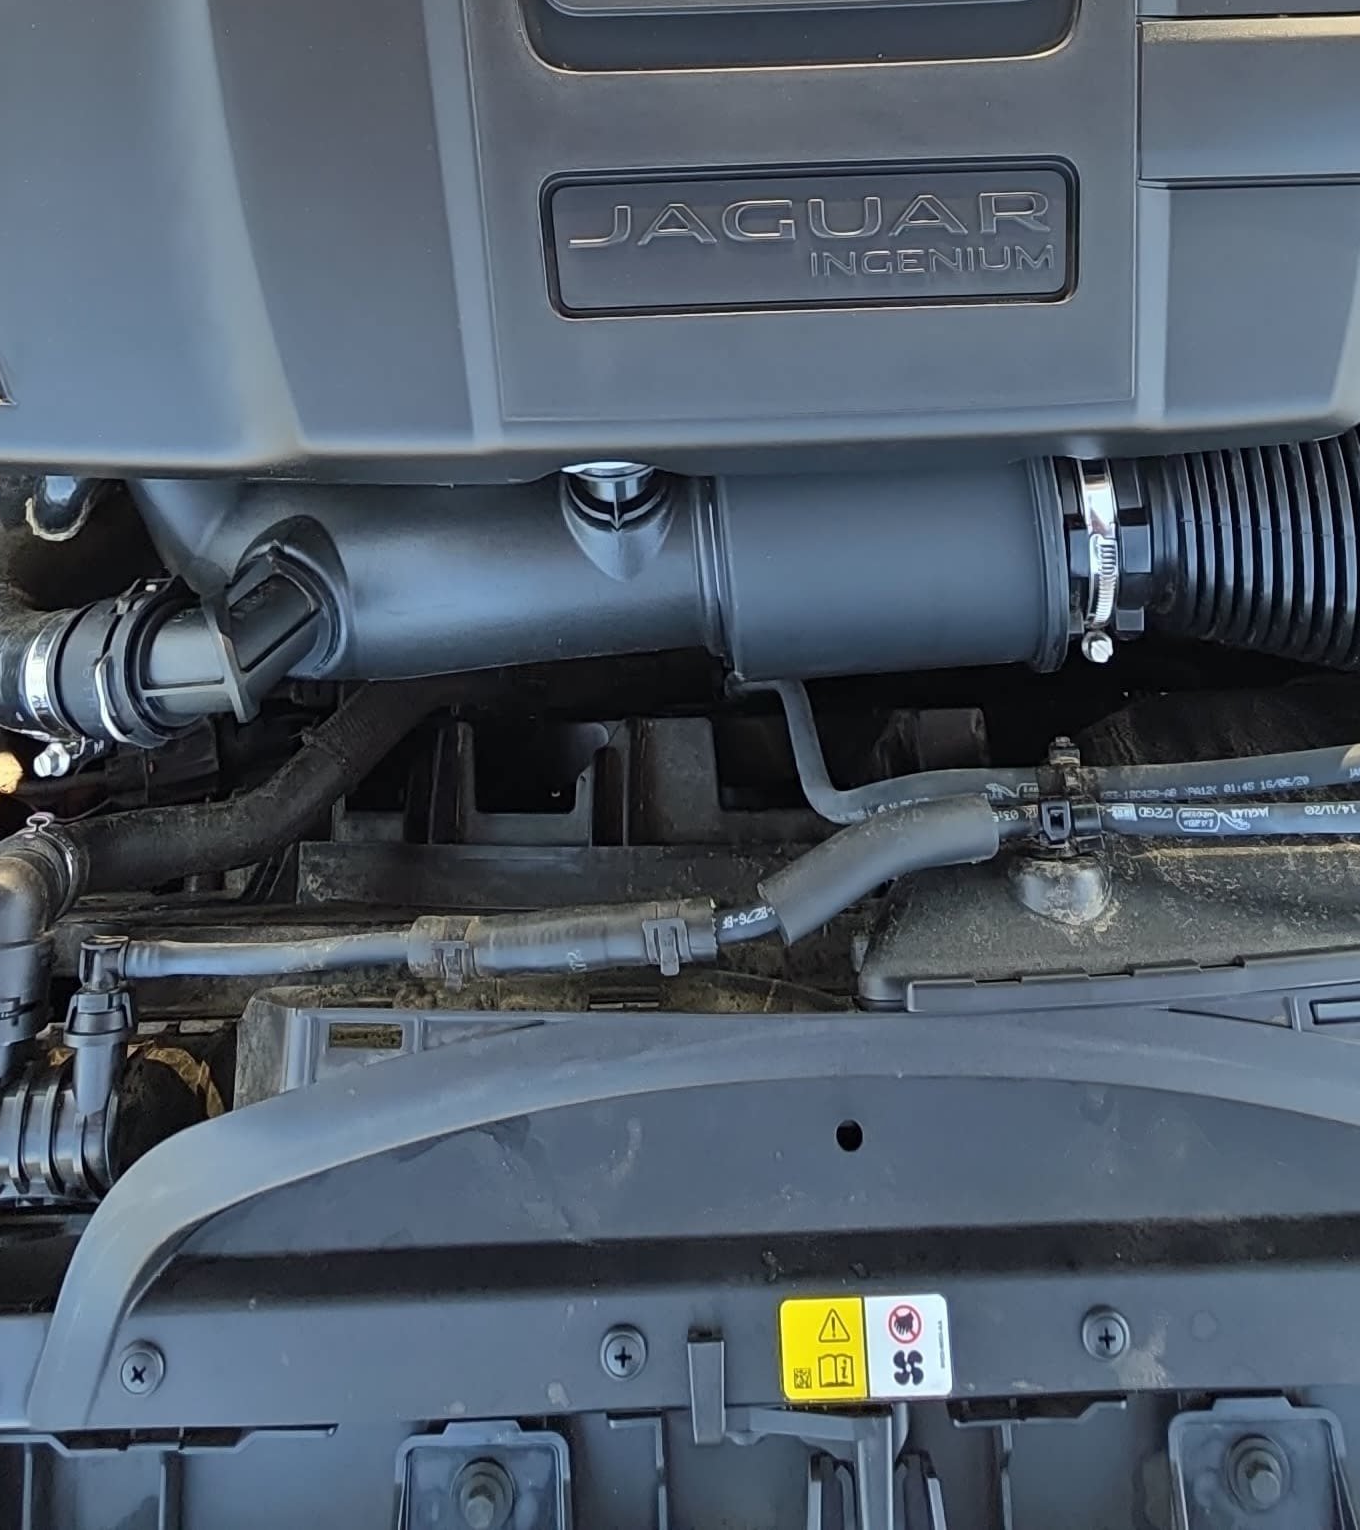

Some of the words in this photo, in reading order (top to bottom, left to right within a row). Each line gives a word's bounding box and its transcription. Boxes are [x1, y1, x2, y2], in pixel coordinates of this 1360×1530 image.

[567, 190, 1052, 248] JAGUAR
[809, 243, 1056, 278] INGENIUM
[1229, 807, 1270, 818] JAGUAR
